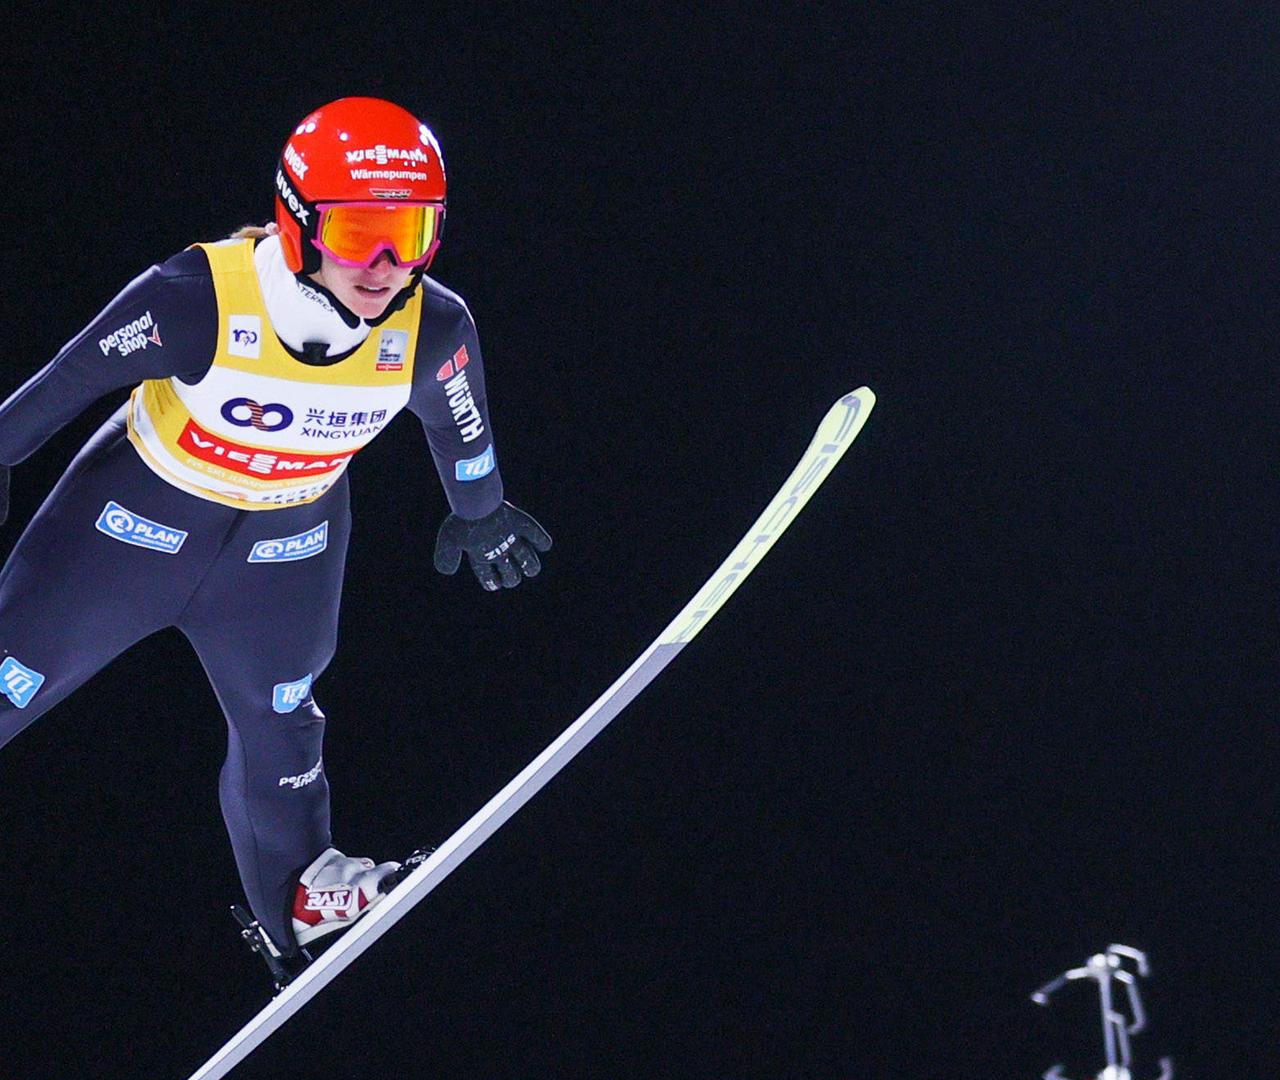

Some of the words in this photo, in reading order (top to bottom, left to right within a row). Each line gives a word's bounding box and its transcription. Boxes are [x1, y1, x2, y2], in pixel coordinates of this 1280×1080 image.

[284, 143, 309, 181] uvex
[350, 169, 428, 182] Wärmepumpen
[276, 169, 310, 226] uvex
[98, 310, 153, 356] personal
[117, 332, 148, 357] shop
[304, 408, 387, 428] 兴垣集团
[443, 369, 485, 444] WÜRTH
[134, 523, 181, 546] PLAN
[286, 529, 324, 553] PLAN
